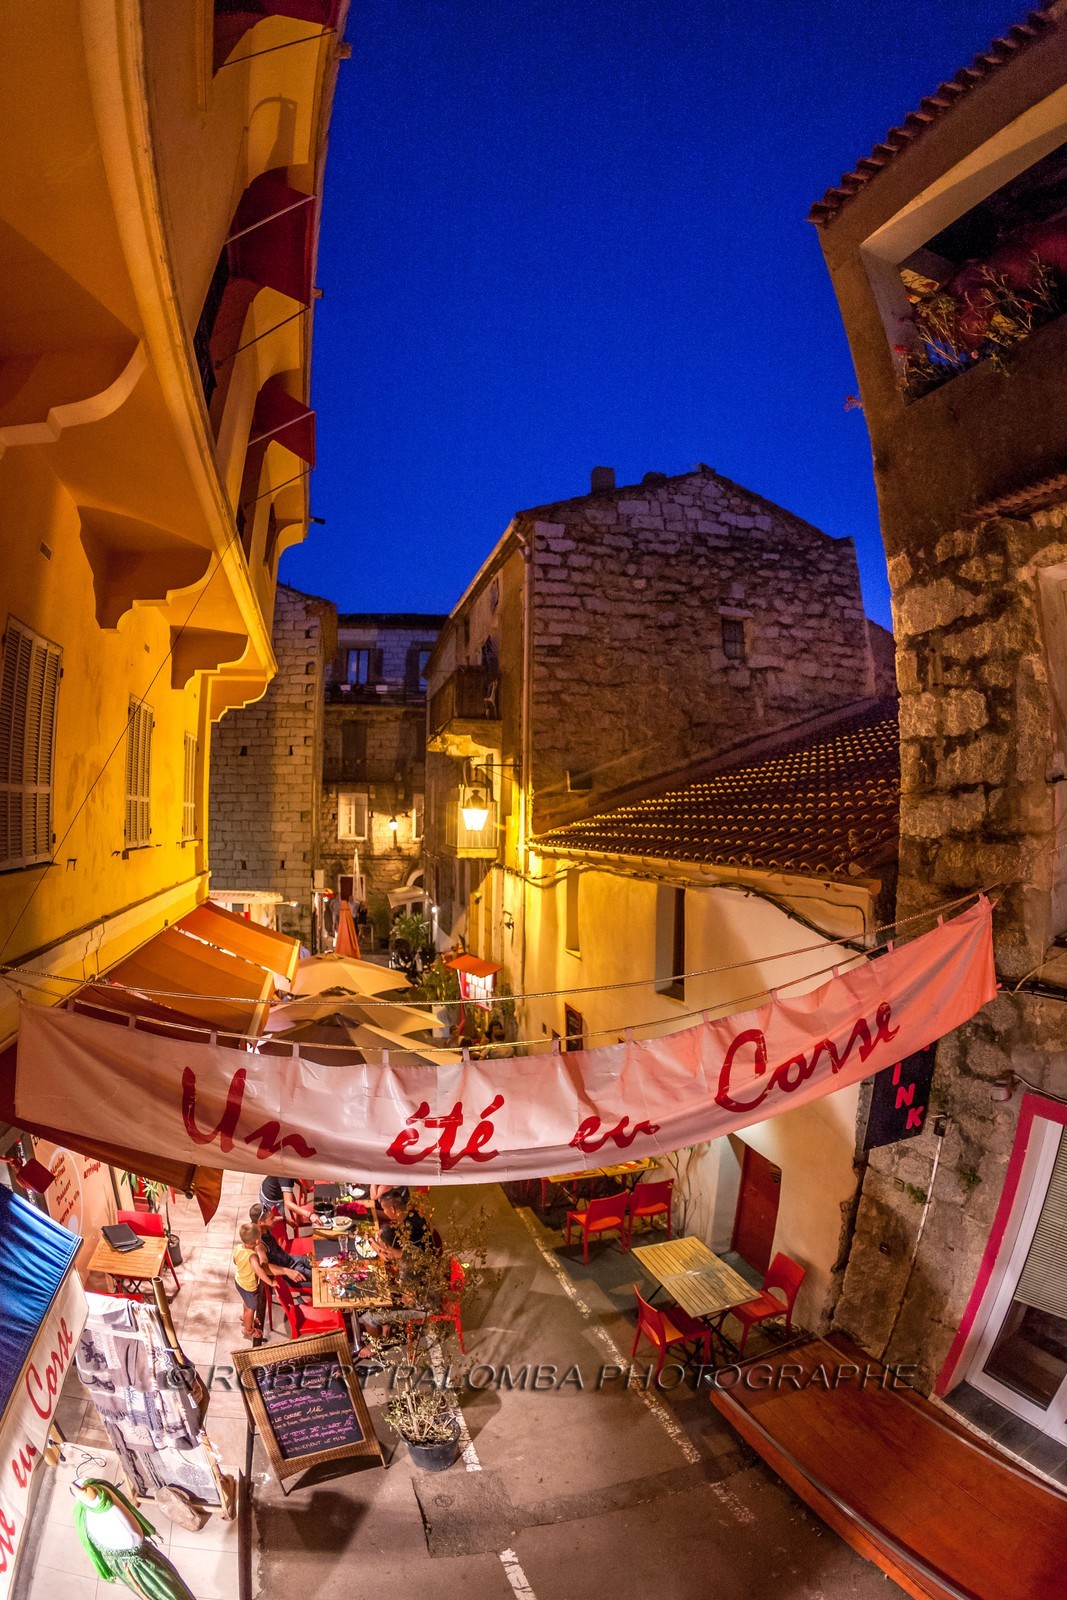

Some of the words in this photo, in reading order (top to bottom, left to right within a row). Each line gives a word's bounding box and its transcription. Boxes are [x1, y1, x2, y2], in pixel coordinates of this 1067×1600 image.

[182, 1066, 317, 1160] Un
[386, 1094, 505, 1170] été
[568, 1115, 660, 1153] en
[714, 1001, 900, 1113] Corse
[11, 1441, 37, 1490] en
[25, 1317, 73, 1420] Corse
